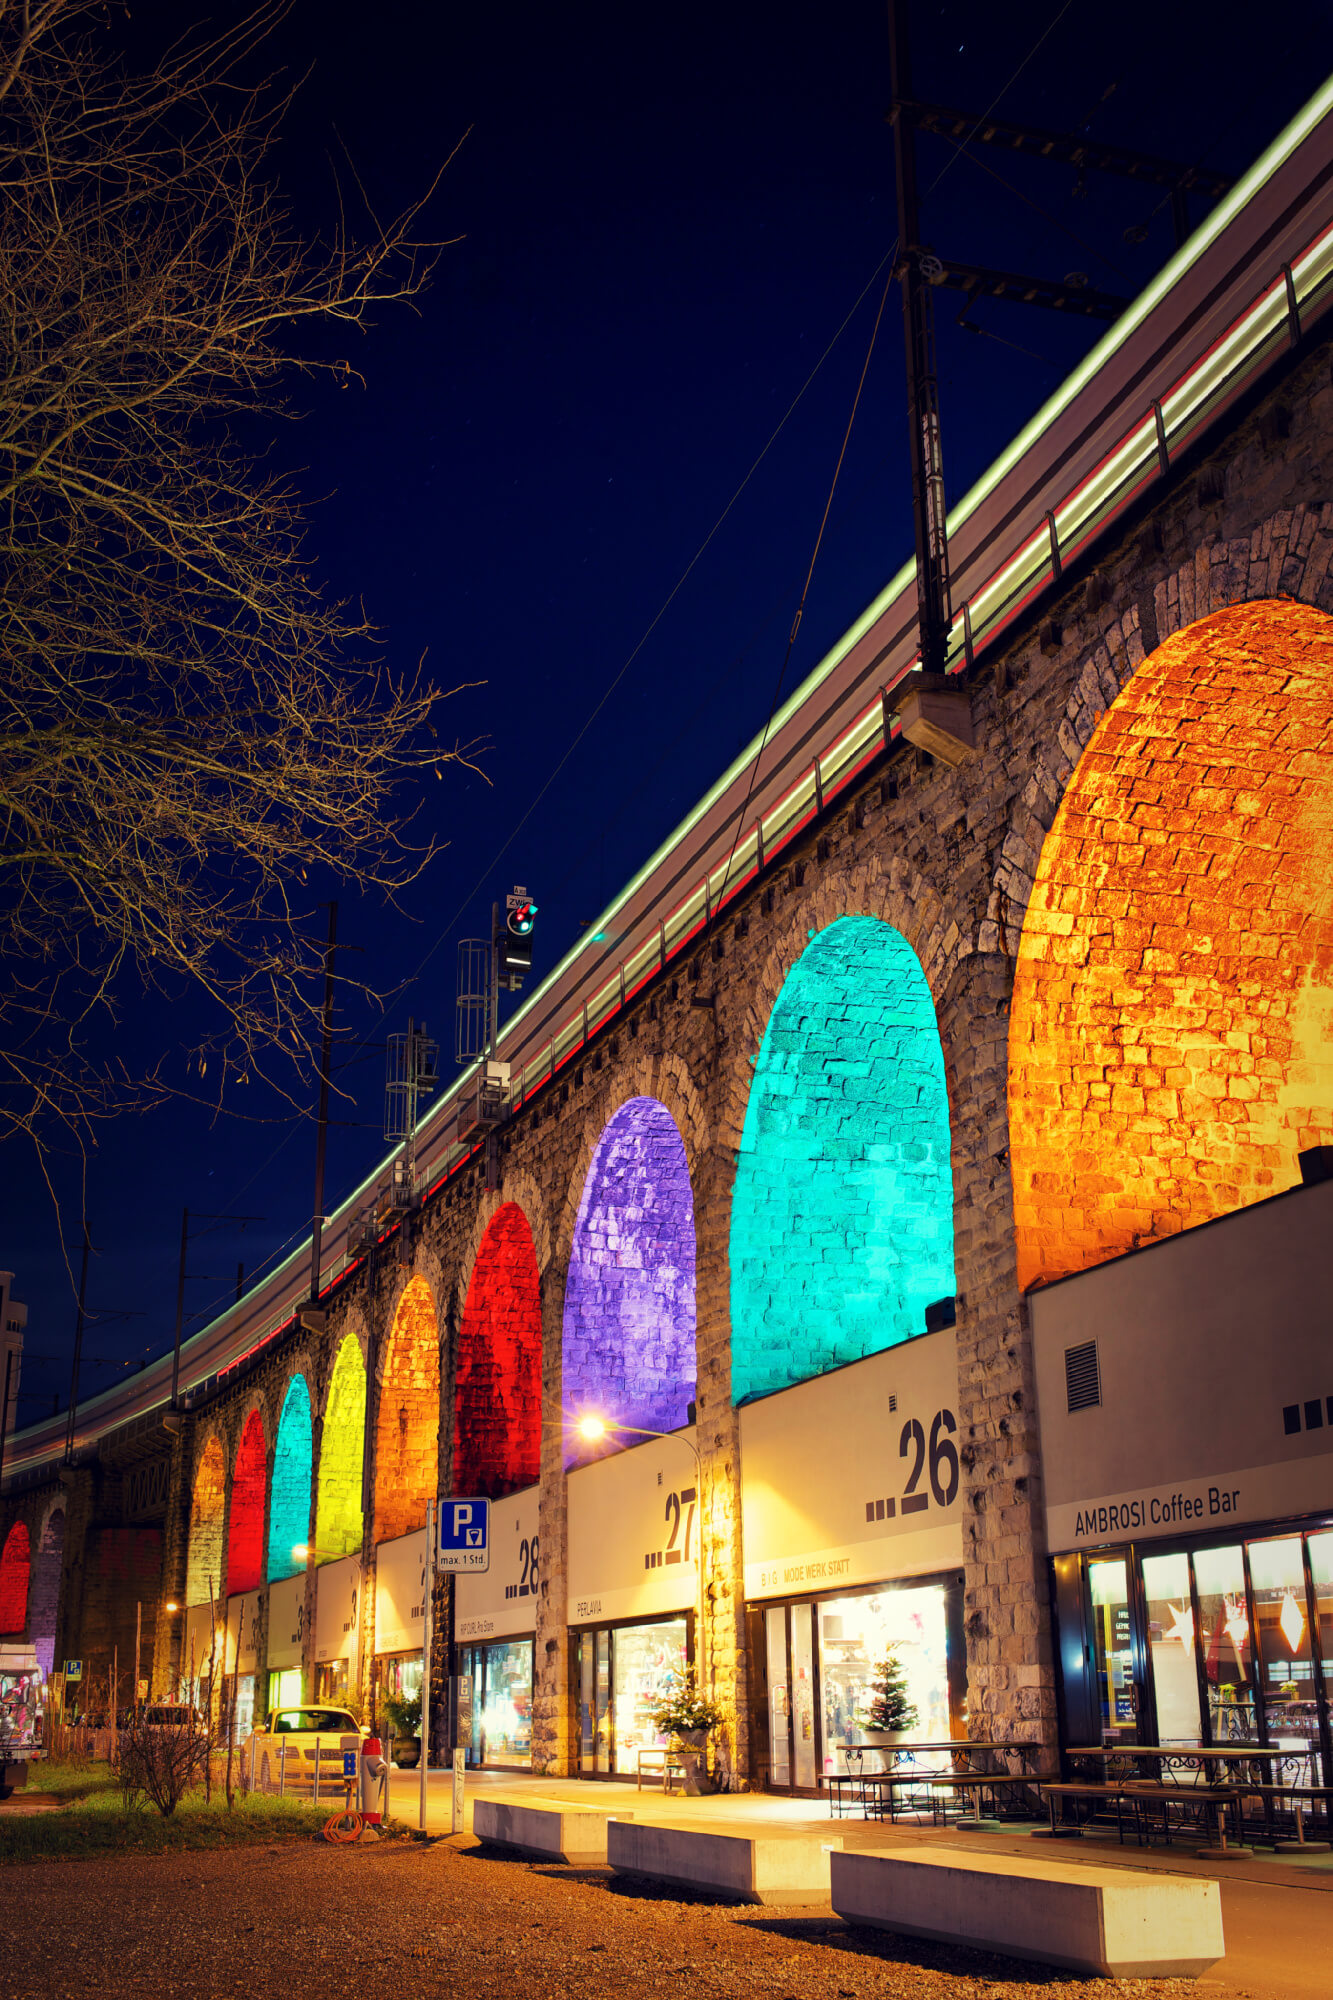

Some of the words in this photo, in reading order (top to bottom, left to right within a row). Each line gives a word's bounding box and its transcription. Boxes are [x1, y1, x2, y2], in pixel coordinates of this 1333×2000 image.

[453, 1504, 473, 1537] P
[1075, 1500, 1146, 1537] AMBROSI
[1151, 1493, 1203, 1525] Coffee
[1208, 1487, 1241, 1515] Bar
[440, 1556, 461, 1565] max.
[463, 1554, 467, 1565] 1
[469, 1553, 486, 1565] Std.
[783, 1566, 805, 1583] MODE
[828, 1558, 850, 1576] STATT
